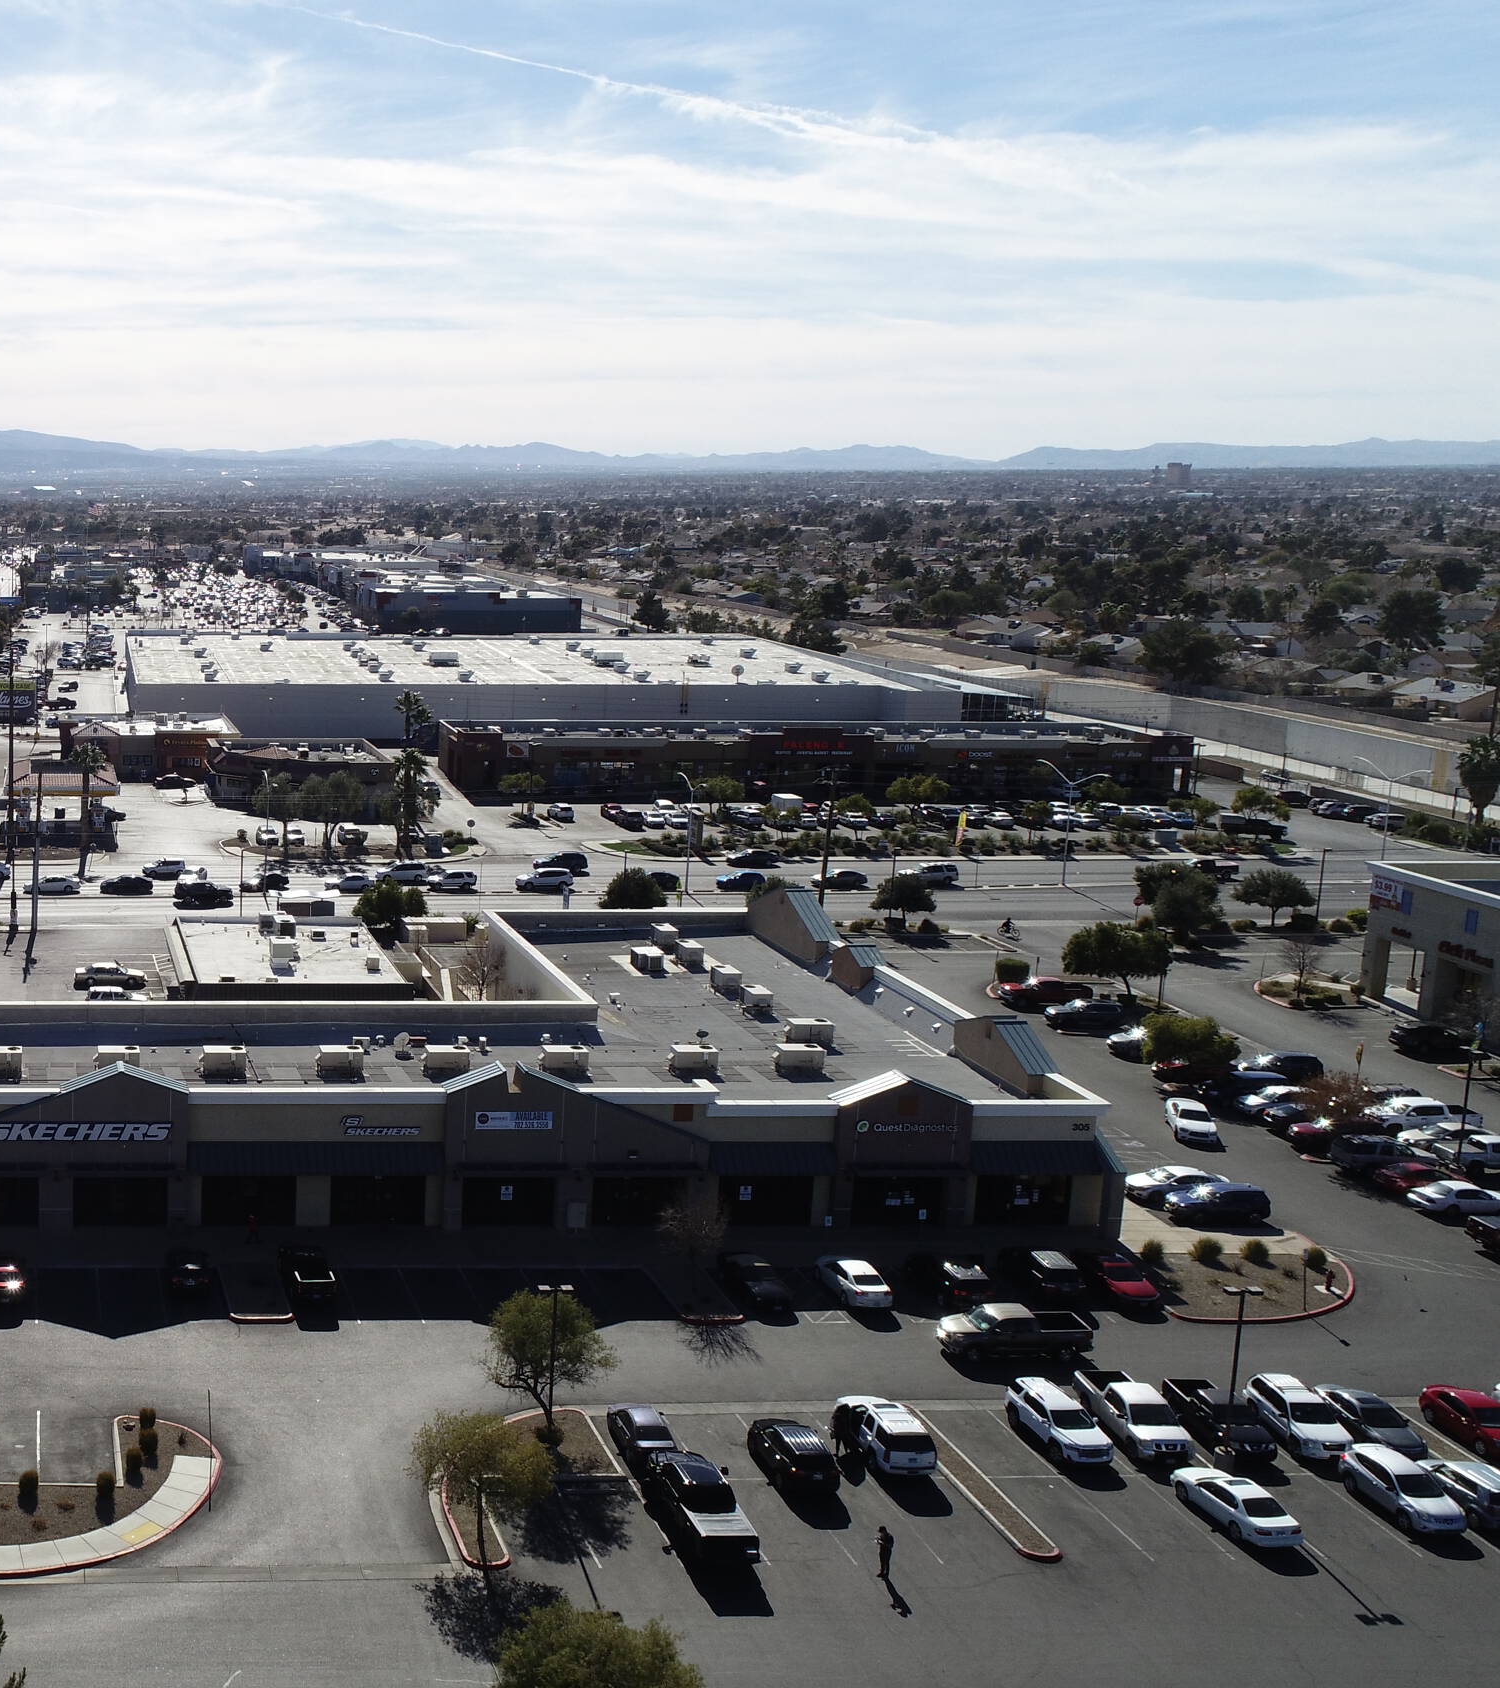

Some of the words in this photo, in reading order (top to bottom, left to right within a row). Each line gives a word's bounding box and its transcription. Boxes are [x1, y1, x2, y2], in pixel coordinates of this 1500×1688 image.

[515, 1112, 548, 1120] AVAILABLE
[344, 1126, 420, 1137] SKECHERS
[1072, 1123, 1090, 1132] 305
